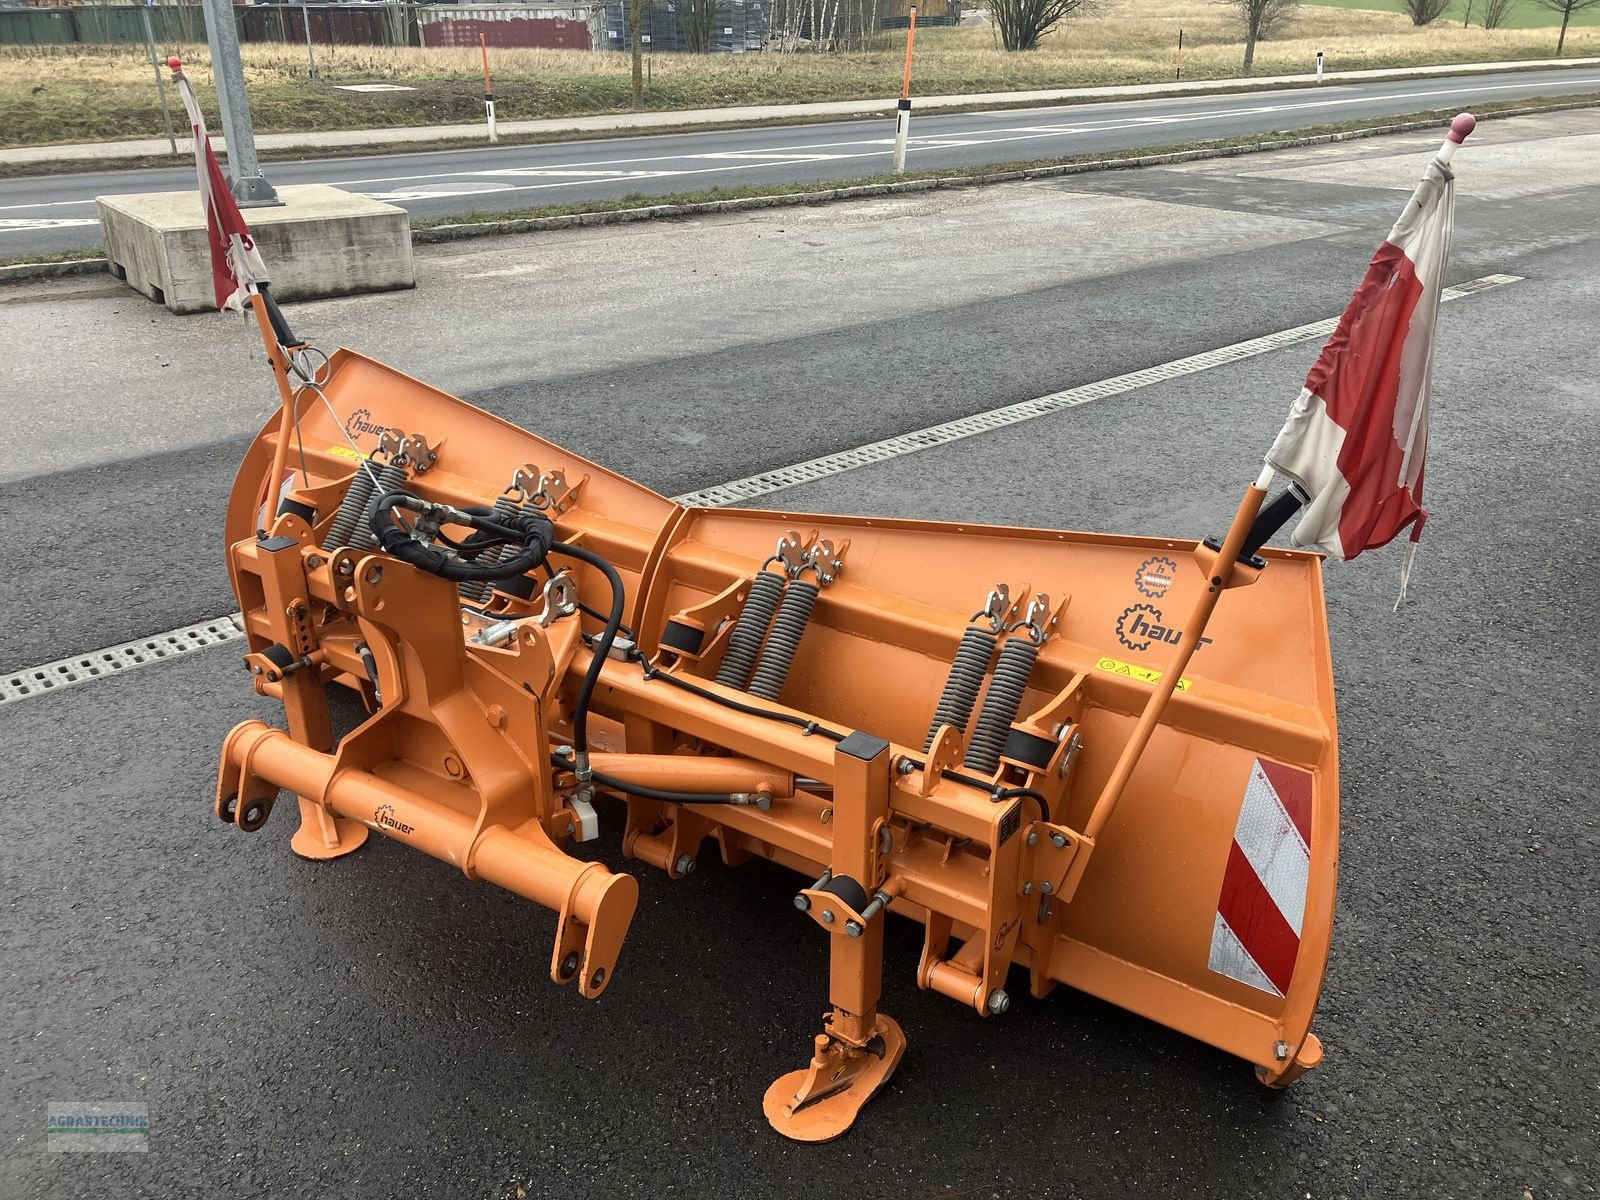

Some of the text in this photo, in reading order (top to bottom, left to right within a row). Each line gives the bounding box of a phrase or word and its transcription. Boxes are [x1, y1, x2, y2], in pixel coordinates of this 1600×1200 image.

[352, 415, 391, 436] haue
[1129, 613, 1213, 651] haur
[380, 811, 415, 835] hauer
